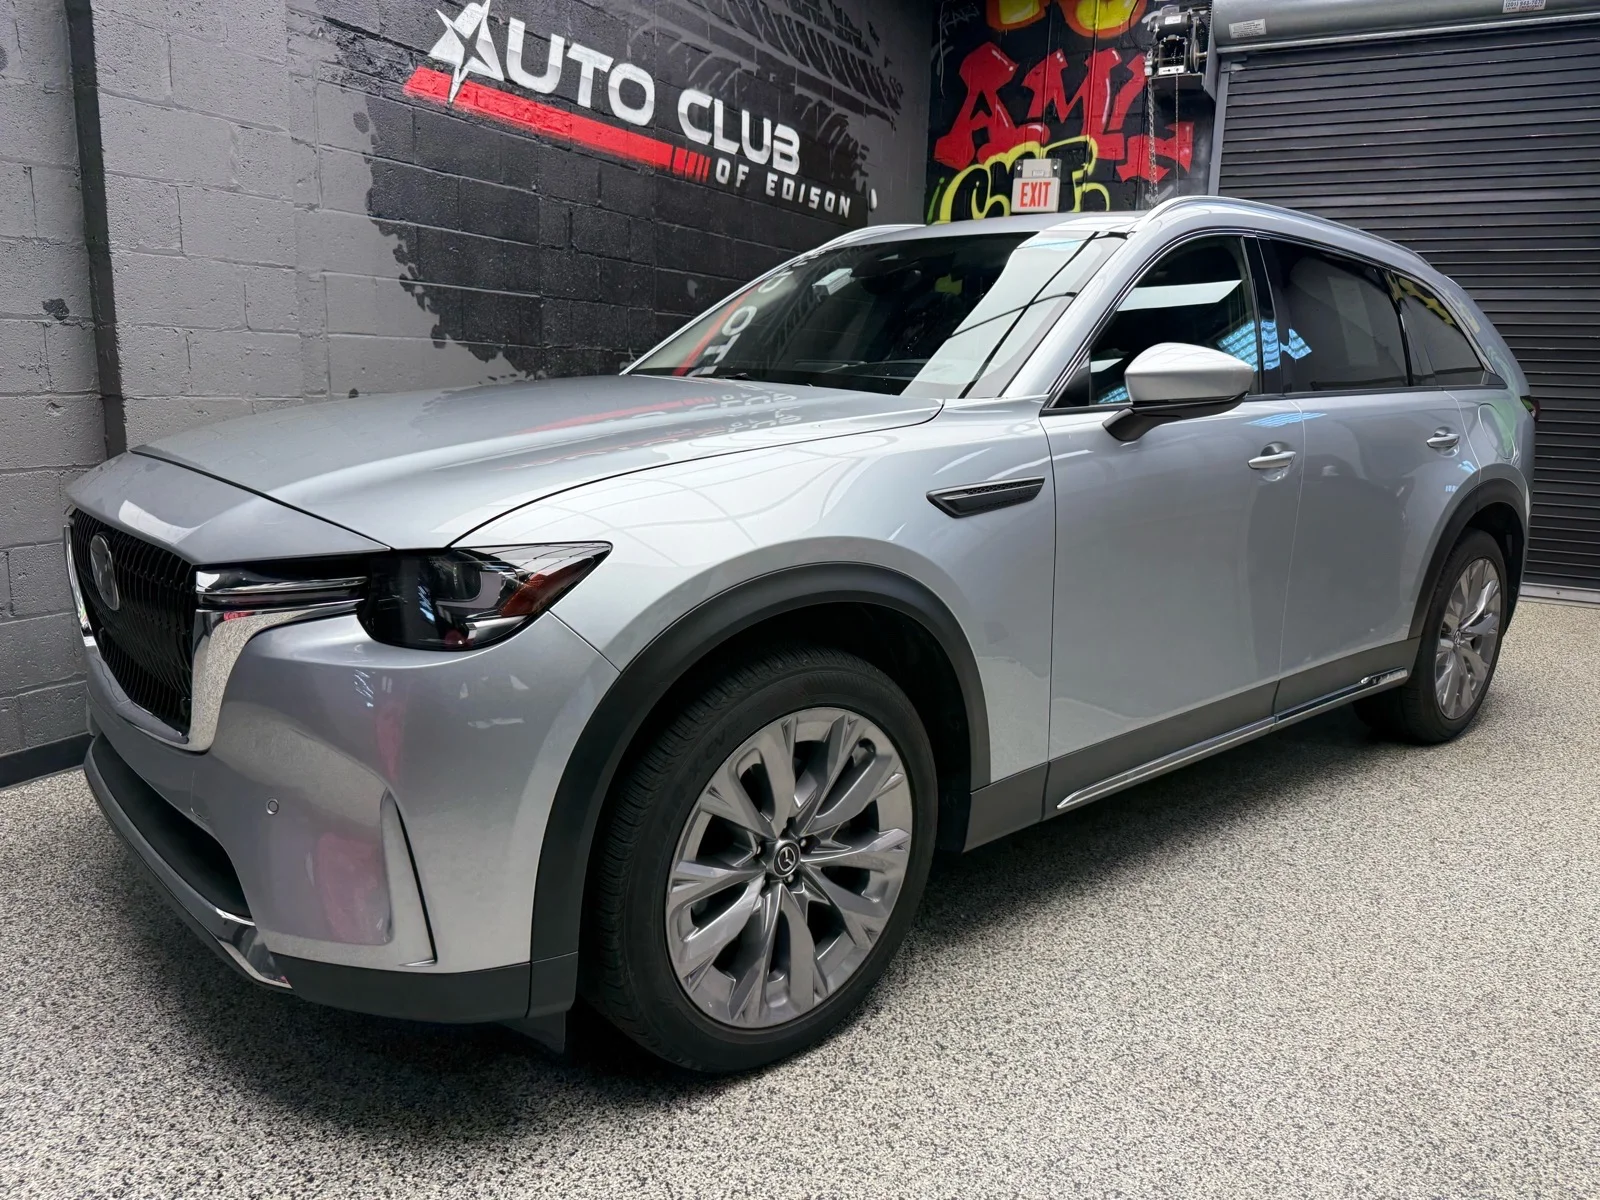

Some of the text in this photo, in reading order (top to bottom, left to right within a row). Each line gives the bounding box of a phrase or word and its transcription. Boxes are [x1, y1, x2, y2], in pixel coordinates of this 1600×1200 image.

[428, 0, 801, 175] AUTO CLUB
[715, 157, 851, 219] OF EDISON
[1020, 181, 1051, 208] EXIT
